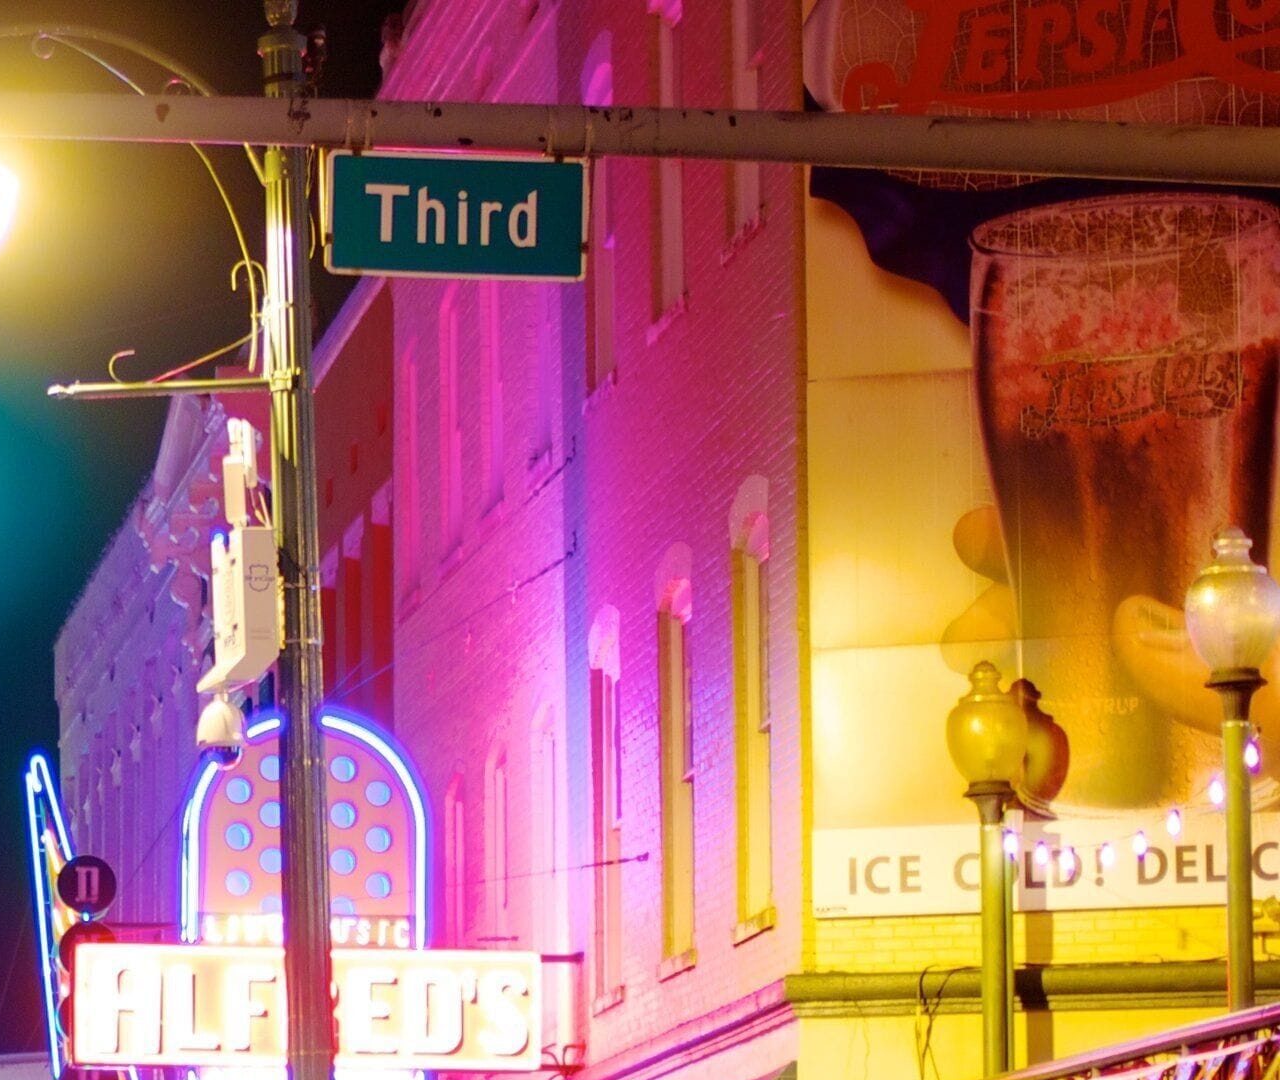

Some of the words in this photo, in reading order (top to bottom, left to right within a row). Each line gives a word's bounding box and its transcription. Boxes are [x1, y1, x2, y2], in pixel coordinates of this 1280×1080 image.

[365, 183, 537, 247] Third
[848, 856, 922, 895] ICE
[953, 844, 1106, 892] CLD!
[1137, 842, 1280, 886] DELC
[328, 917, 411, 948] USIC
[95, 962, 530, 1057] ALFED'S
